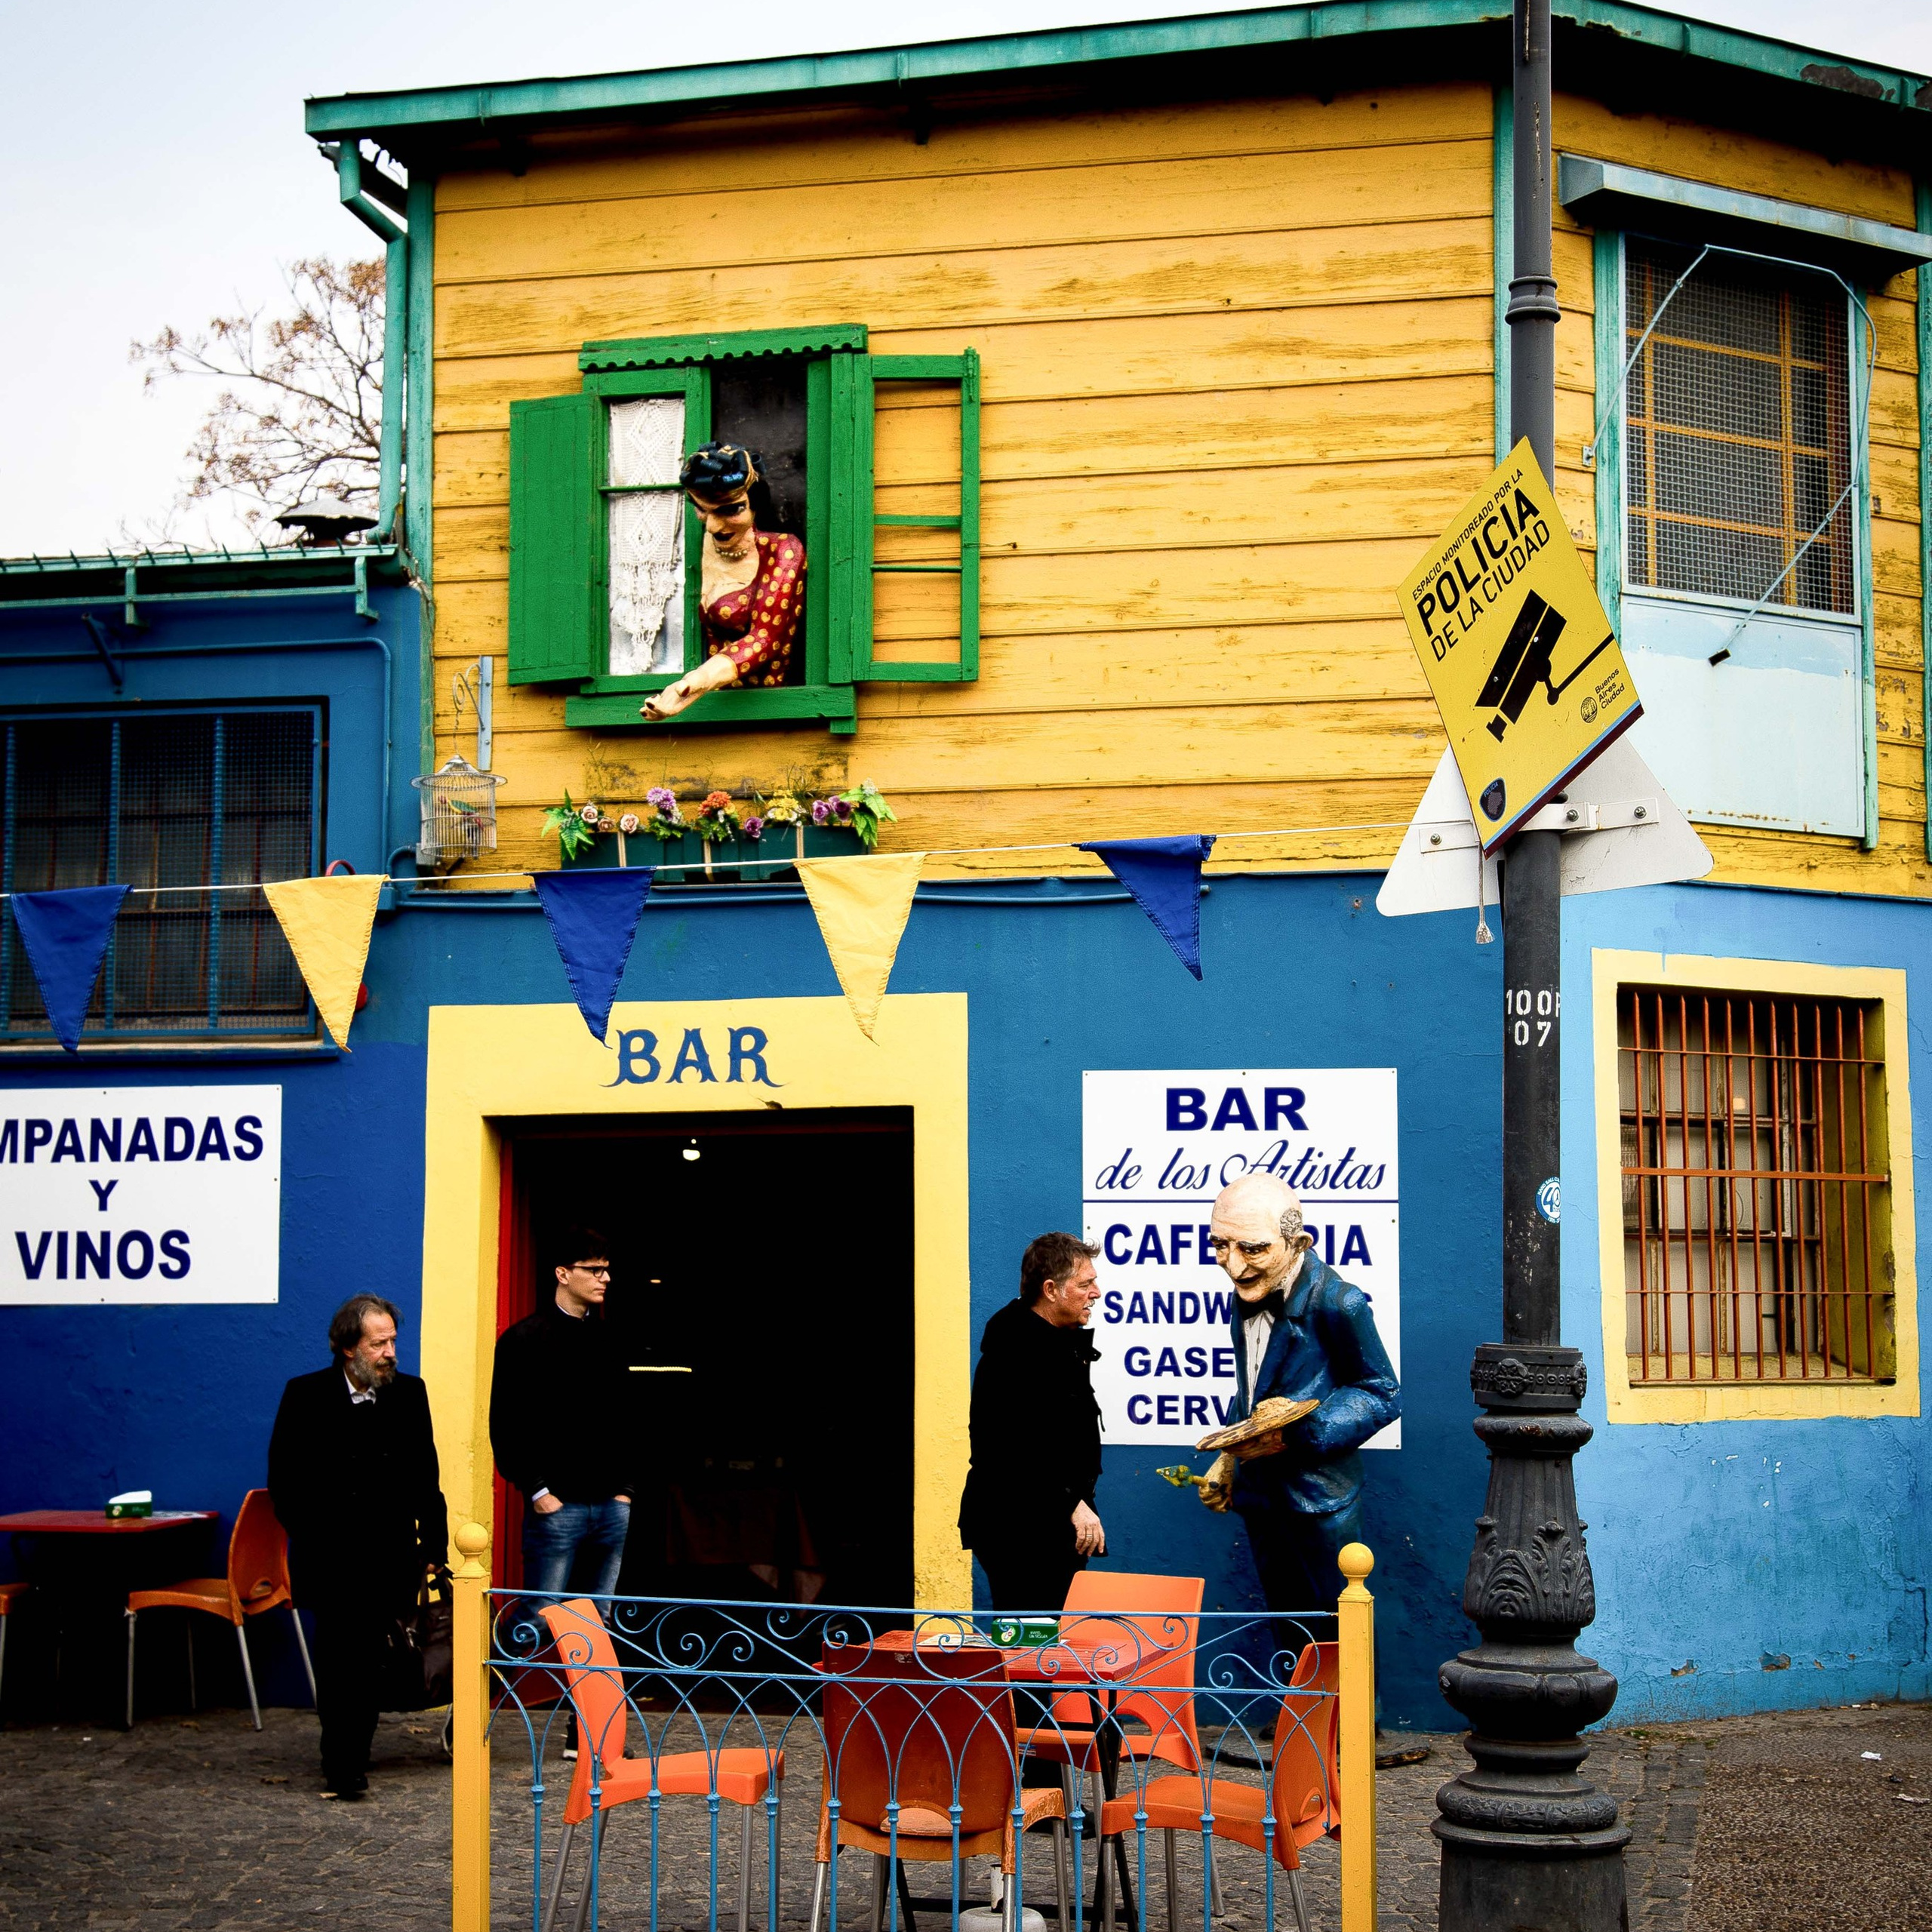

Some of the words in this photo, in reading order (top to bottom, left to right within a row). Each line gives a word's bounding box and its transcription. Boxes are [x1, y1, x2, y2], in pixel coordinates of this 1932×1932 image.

[1412, 561, 1442, 601] ESPACIO
[1441, 501, 1494, 565] MONITOREADO
[1494, 481, 1512, 503] POR
[1511, 468, 1523, 484] LA
[1417, 487, 1540, 637] POLICIA
[1430, 620, 1459, 663] DE
[1457, 596, 1484, 632] LA
[1481, 519, 1550, 603] CIUDAD
[1595, 669, 1620, 694] Buenos
[1598, 682, 1617, 703] Aires
[1601, 683, 1625, 709] Ciudad
[1515, 1020, 1551, 1047] 07
[598, 1026, 791, 1088] BAR
[1166, 1087, 1309, 1131] BAR
[1095, 1147, 1143, 1189] de
[1158, 1147, 1211, 1189] los
[1220, 1139, 1386, 1189] Artistas
[88, 1180, 118, 1211] Y
[15, 1229, 191, 1280] VINOS
[1104, 1223, 1373, 1266] CAFEIA
